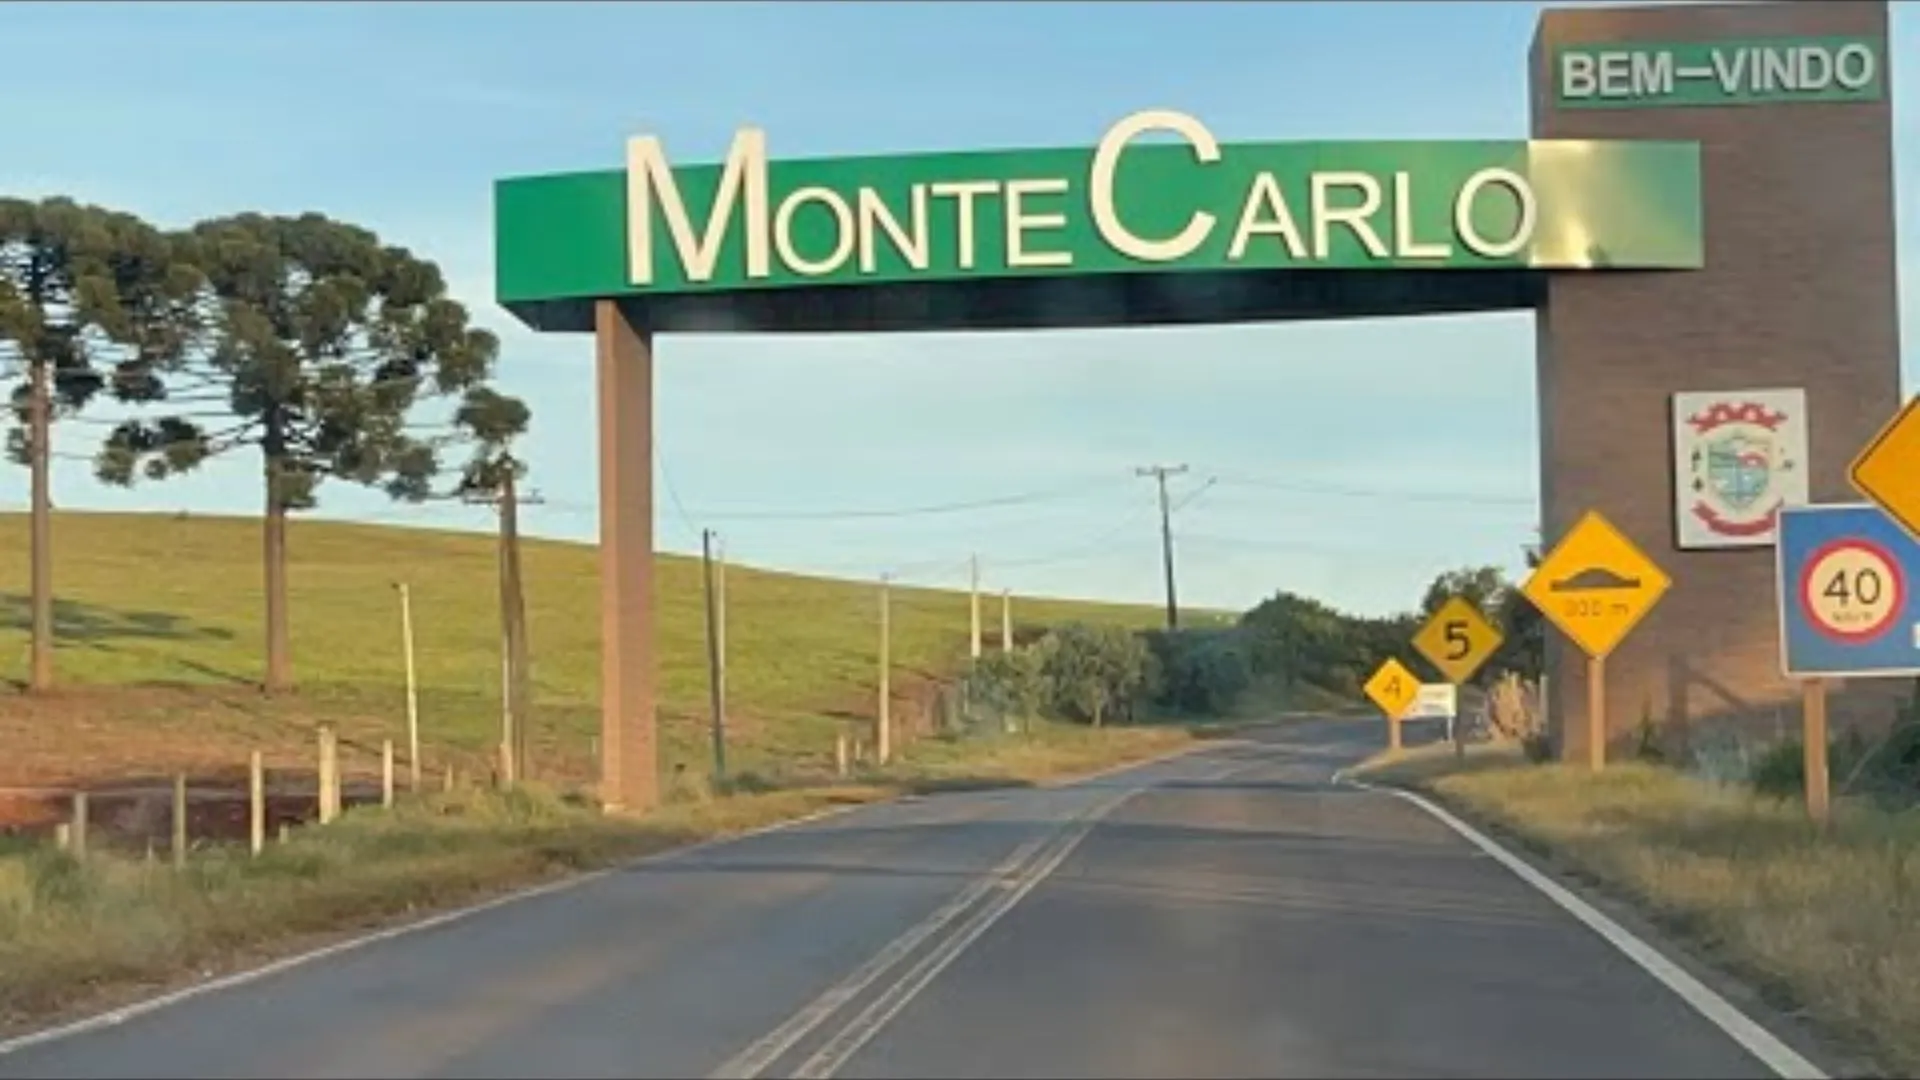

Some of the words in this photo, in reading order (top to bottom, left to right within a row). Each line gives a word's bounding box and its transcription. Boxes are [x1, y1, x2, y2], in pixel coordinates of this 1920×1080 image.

[1561, 43, 1874, 98] BEM-VINDO
[624, 124, 1074, 285] MONTE
[1089, 109, 1537, 262] CARLO
[1823, 567, 1881, 607] 40
[1445, 620, 1471, 662] 5
